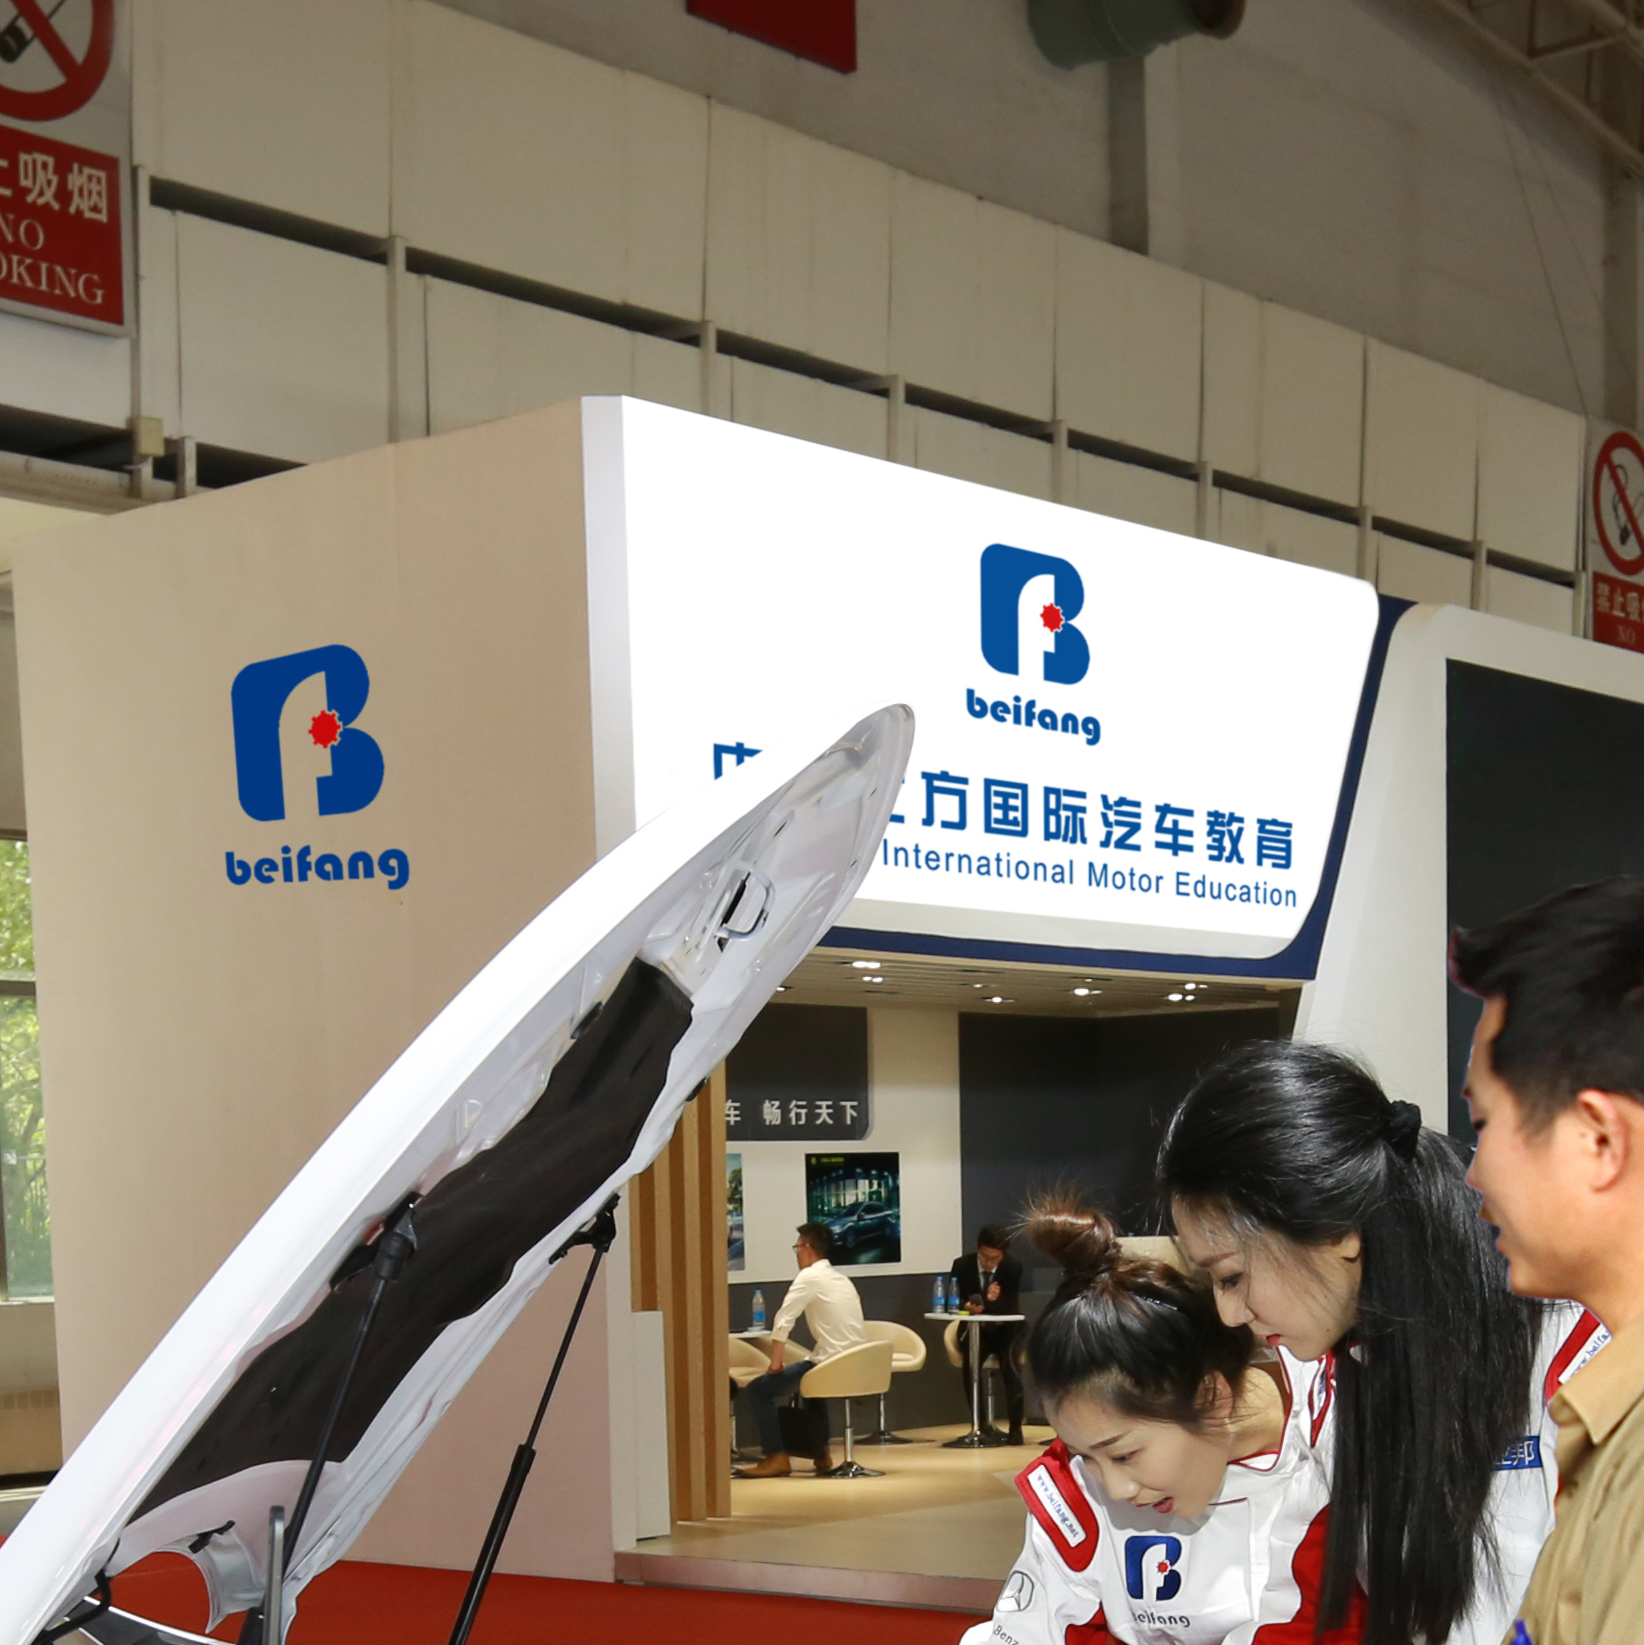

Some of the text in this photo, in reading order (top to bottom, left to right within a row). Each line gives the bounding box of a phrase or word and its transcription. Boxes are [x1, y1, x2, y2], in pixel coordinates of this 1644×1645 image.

[966, 689, 1102, 746] beifang
[224, 843, 410, 891] beifang
[882, 838, 1297, 907] International Motor Education
[763, 1099, 858, 1125] 畅行天下
